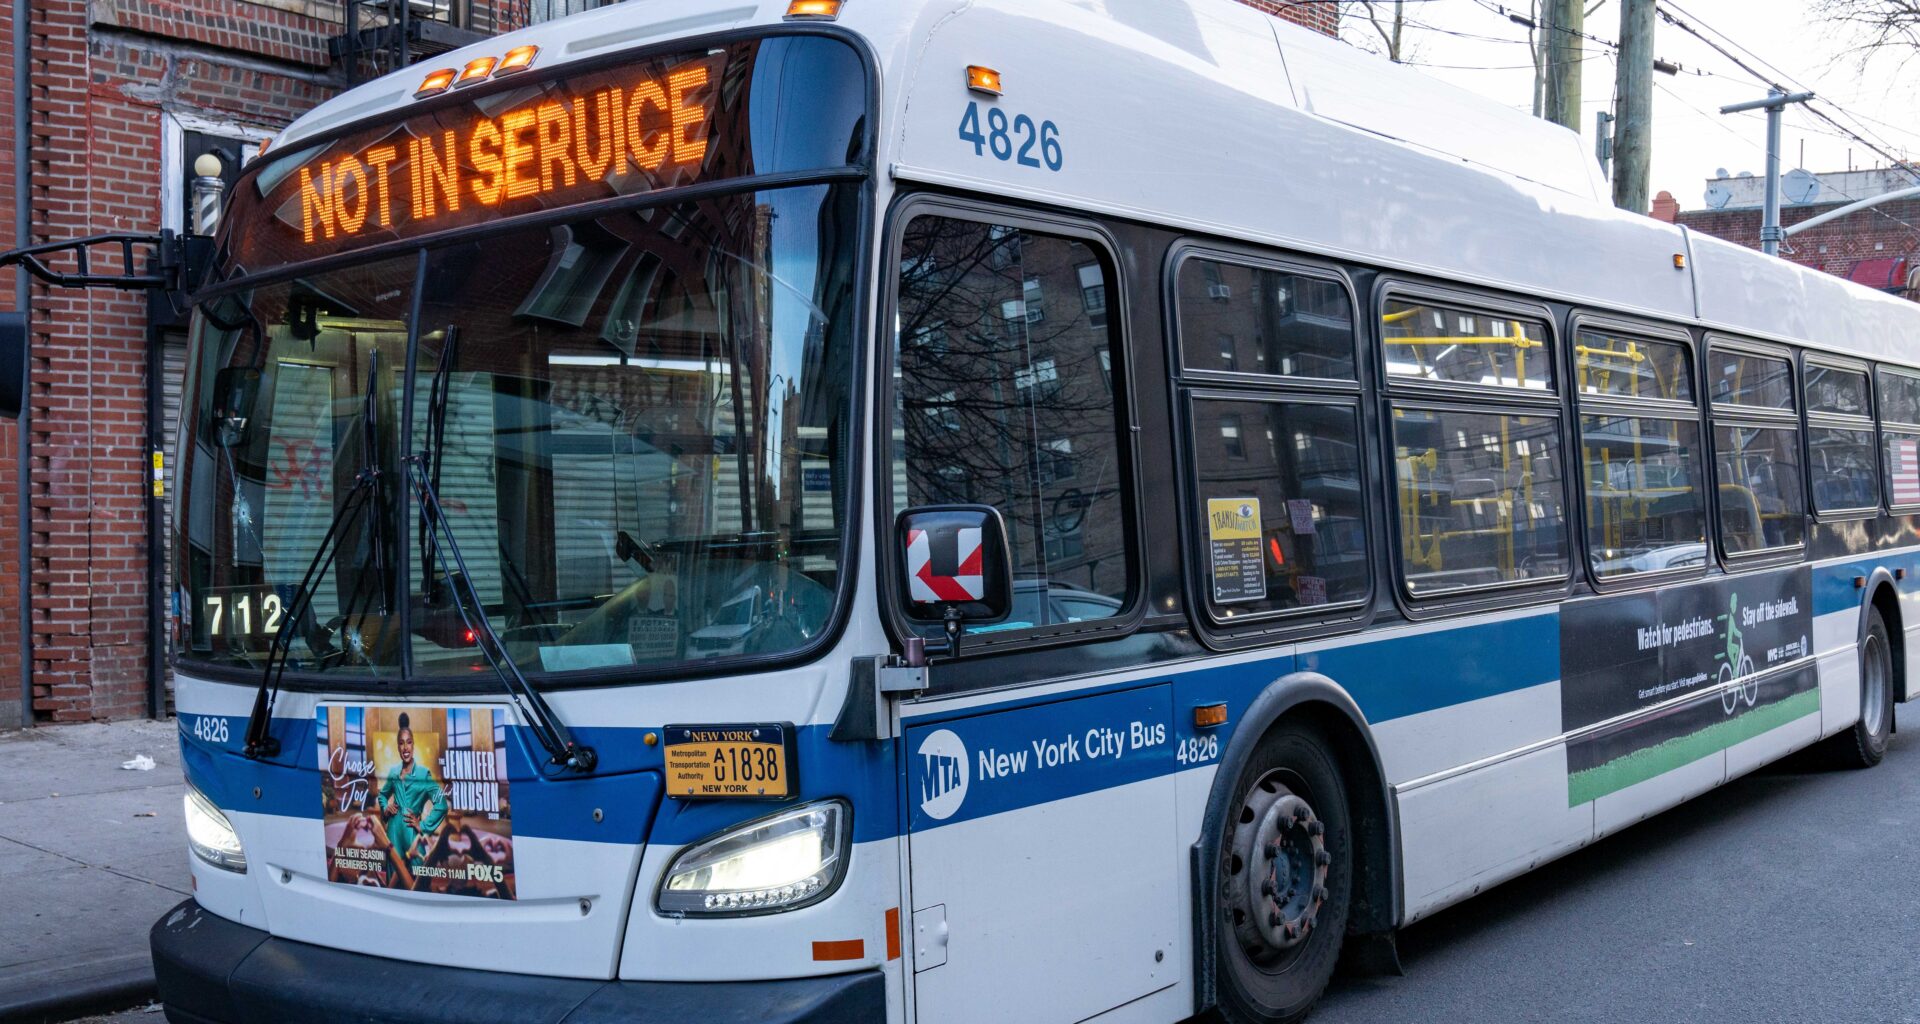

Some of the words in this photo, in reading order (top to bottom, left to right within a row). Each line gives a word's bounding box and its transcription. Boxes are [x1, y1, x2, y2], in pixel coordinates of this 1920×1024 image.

[959, 101, 1063, 172] 4826
[300, 145, 396, 243] NOT
[409, 130, 460, 220] IN
[470, 67, 709, 206] SERVICE
[1212, 510, 1239, 531] TRANSIT
[207, 594, 281, 635] 712
[1742, 605, 1756, 629] Stay
[1756, 602, 1765, 624] off
[1765, 601, 1775, 621] the
[1774, 596, 1799, 619] sidewalk.
[1637, 625, 1662, 650] Watch
[1662, 622, 1673, 646] for
[1673, 615, 1714, 648] pedestrians.
[194, 716, 229, 743] 4826
[692, 731, 720, 742] NEW
[722, 730, 753, 742] YORK
[328, 746, 376, 780] Choose
[443, 750, 496, 780] JENNIFER
[669, 761, 711, 769] Transportation
[671, 750, 707, 758] Metropolitan
[978, 748, 1028, 781] New
[1032, 734, 1080, 769] York
[1085, 727, 1125, 759] City
[1130, 720, 1166, 750] Bus
[1176, 735, 1218, 766] 4826
[702, 785, 721, 793] NEW
[723, 784, 749, 793] YORK
[919, 752, 962, 803] MTA
[340, 778, 369, 813] Joy
[452, 780, 499, 812] HUDSON
[334, 847, 346, 857] ALL
[346, 848, 360, 859] NEW
[360, 848, 385, 861] SEASON
[335, 858, 368, 871] PREMIERES
[368, 860, 382, 872] 9/16
[412, 865, 447, 878] WEEKDAYS
[448, 867, 466, 880] 11AM
